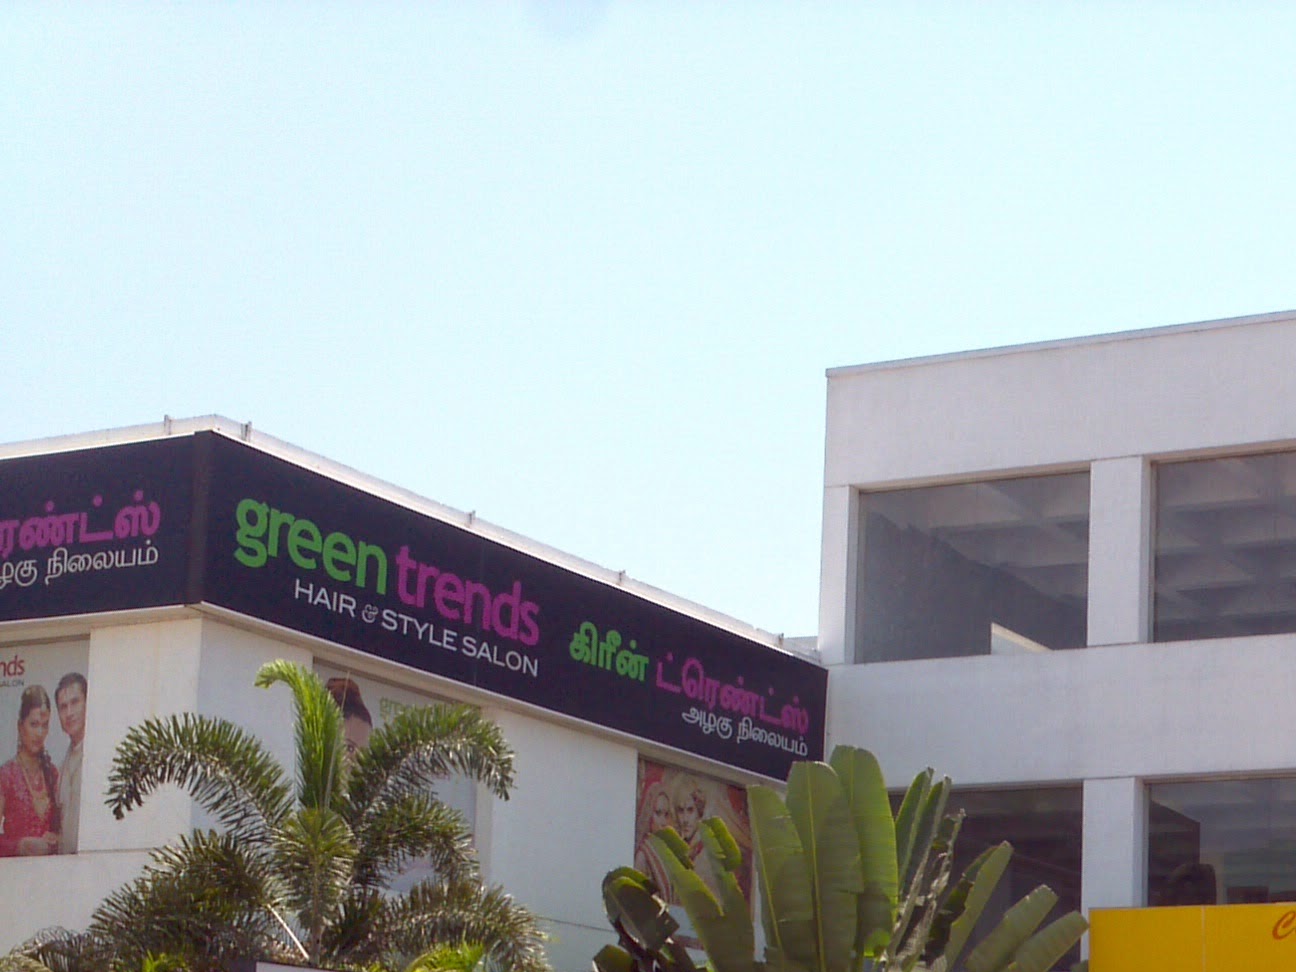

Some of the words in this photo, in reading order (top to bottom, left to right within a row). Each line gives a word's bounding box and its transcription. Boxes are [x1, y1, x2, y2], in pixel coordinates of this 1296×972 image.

[45, 540, 158, 585] நிலையம்
[234, 498, 388, 596] green
[396, 545, 540, 646] trends
[294, 578, 356, 617] HAIR
[362, 604, 378, 623] &
[382, 609, 458, 652] STYLE
[462, 637, 539, 677] SALON
[569, 621, 649, 682] கிரீன்
[682, 706, 733, 740] அழகு
[737, 716, 808, 757] நிலையம்
